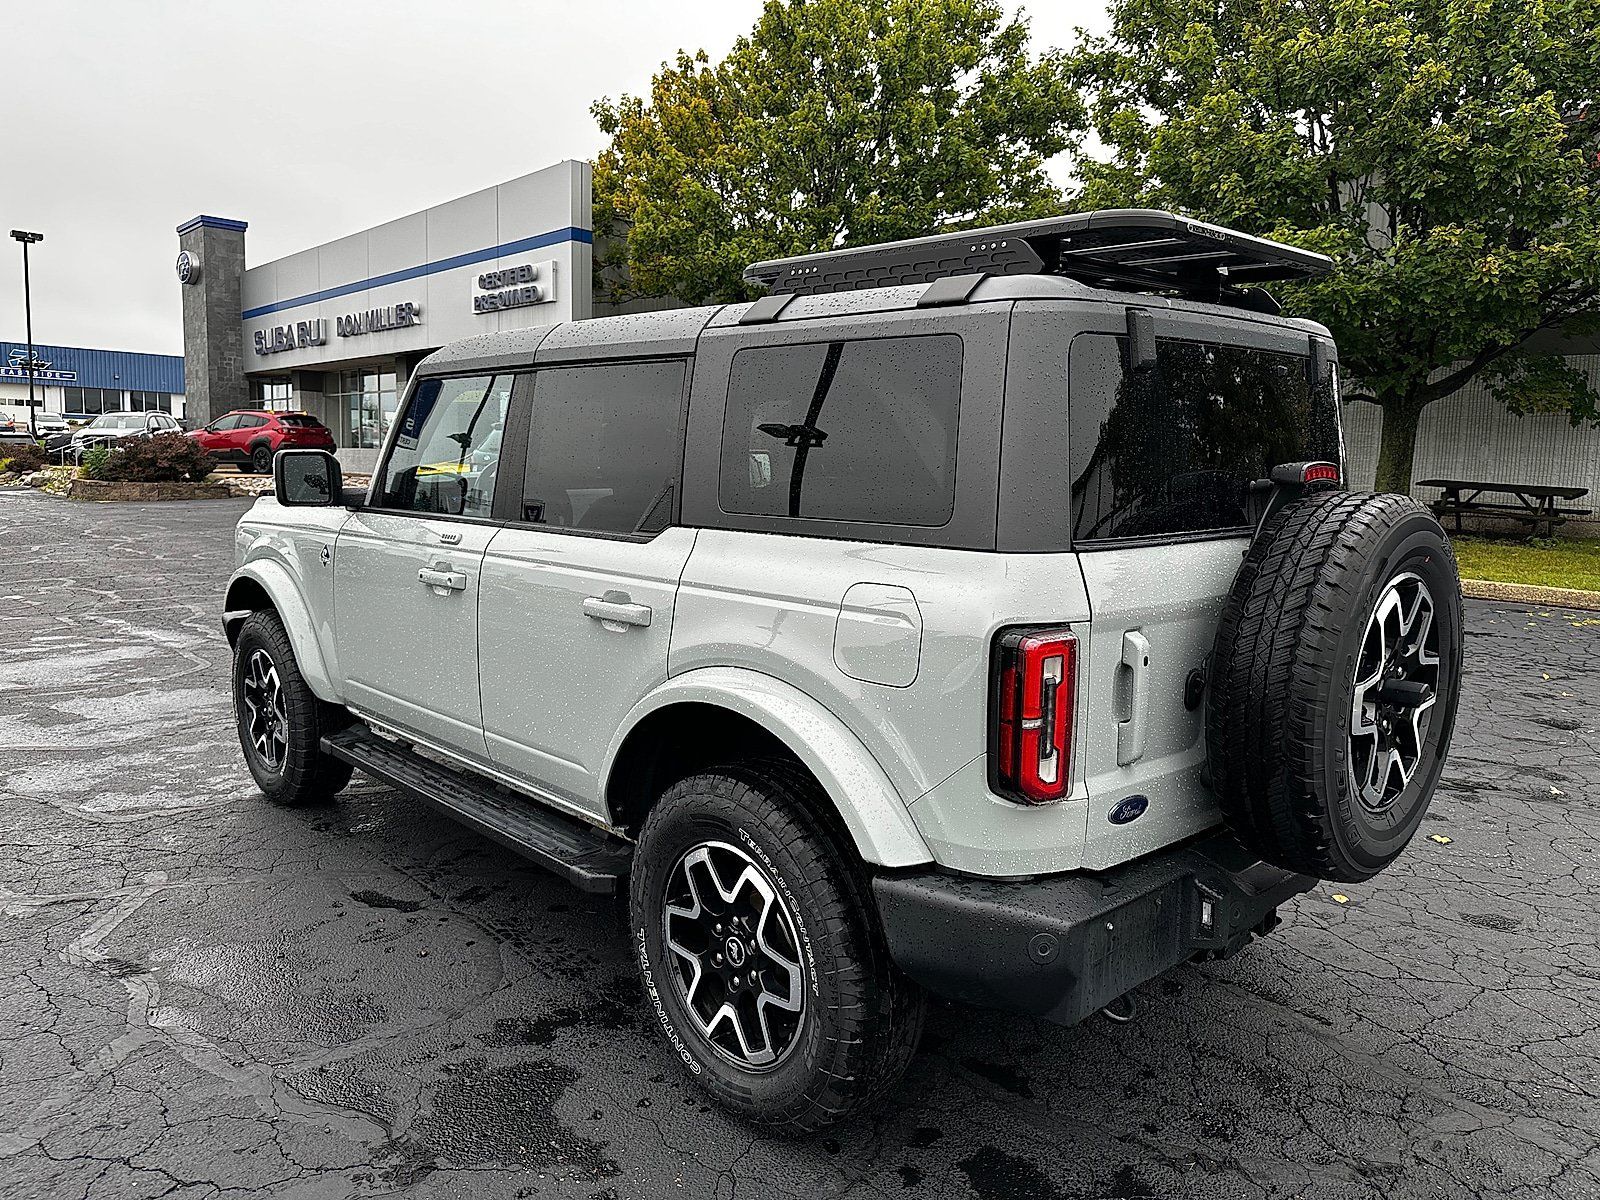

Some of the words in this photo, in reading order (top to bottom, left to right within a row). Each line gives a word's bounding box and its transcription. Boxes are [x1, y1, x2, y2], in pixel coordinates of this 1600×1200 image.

[478, 264, 536, 290] CERTIFIED
[253, 318, 325, 356] SUBARU
[336, 312, 363, 338] DON
[364, 301, 420, 334] MILLER
[636, 927, 702, 1077] CONTINENTAL
